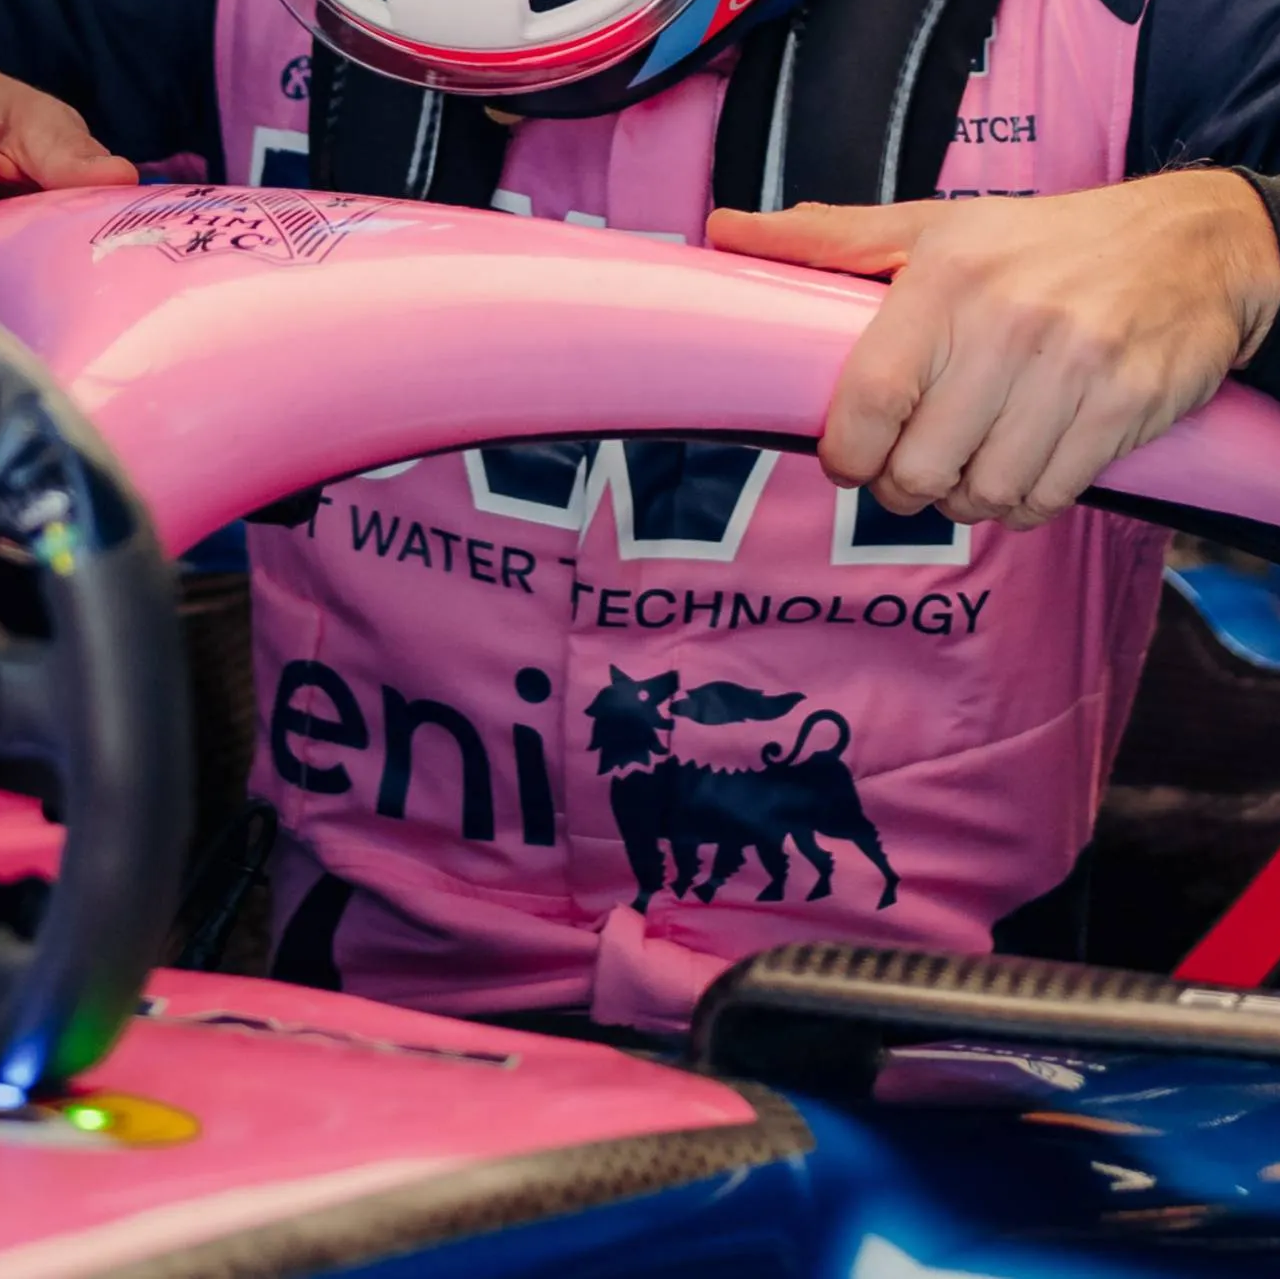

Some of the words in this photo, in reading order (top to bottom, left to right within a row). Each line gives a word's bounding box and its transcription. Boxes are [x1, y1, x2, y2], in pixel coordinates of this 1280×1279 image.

[952, 114, 1038, 144] ATCH
[349, 504, 535, 595] WATER
[558, 557, 991, 636] TECHNOLOGY
[271, 658, 557, 848] eni
